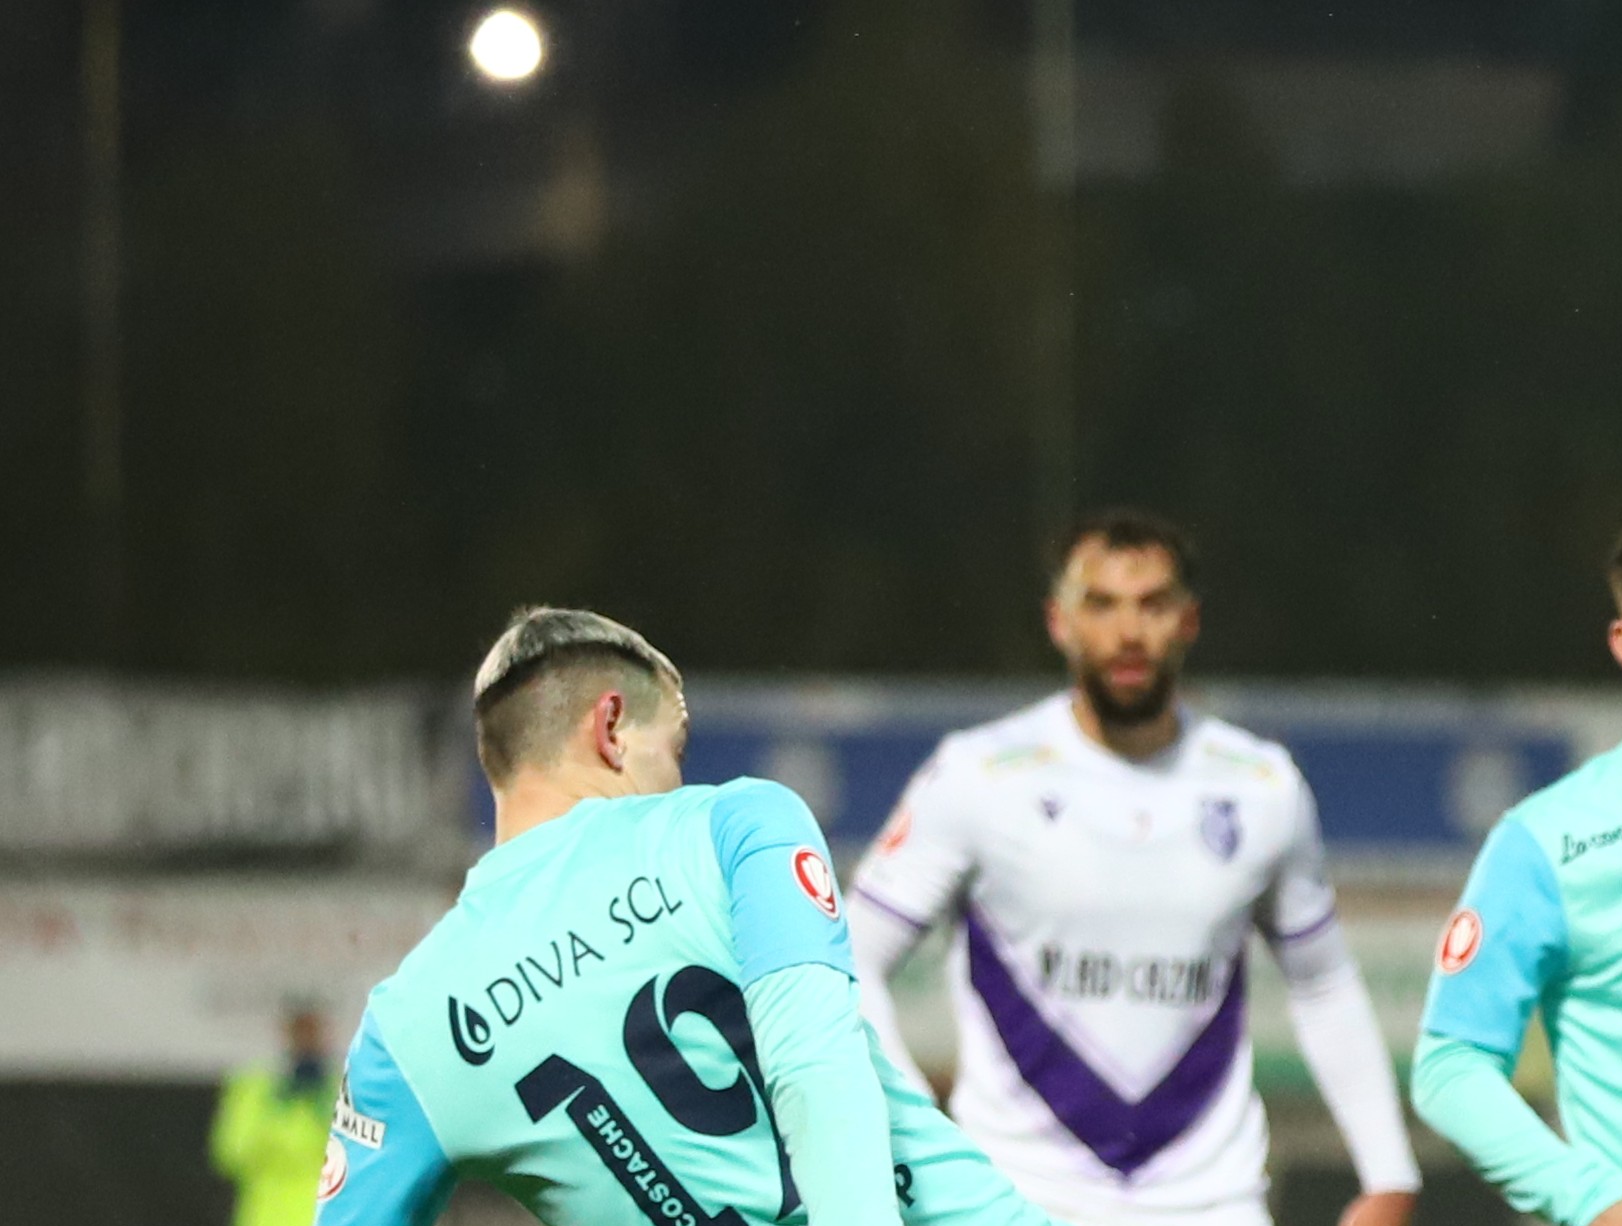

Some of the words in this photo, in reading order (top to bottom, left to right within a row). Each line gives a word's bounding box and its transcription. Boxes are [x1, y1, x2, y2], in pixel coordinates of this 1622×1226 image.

[485, 930, 606, 1028] DIVA
[608, 876, 684, 945] SCL
[340, 1112, 379, 1144] MALL
